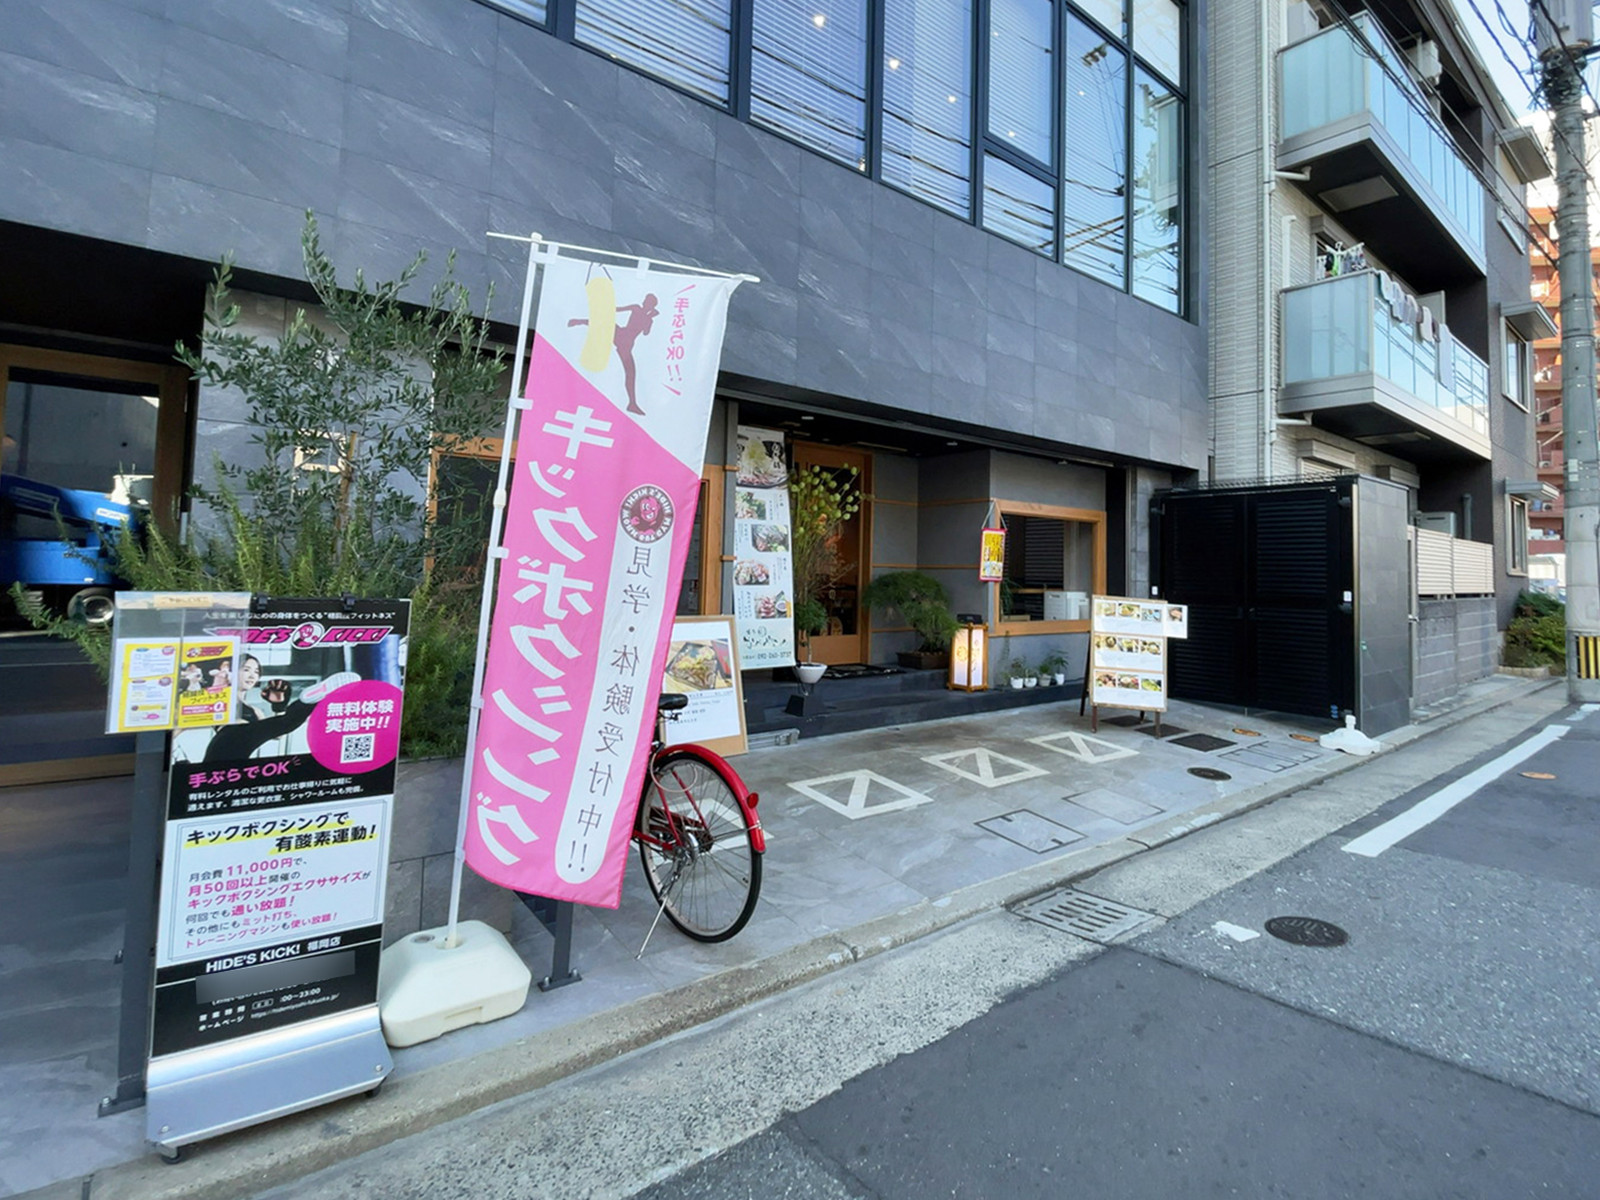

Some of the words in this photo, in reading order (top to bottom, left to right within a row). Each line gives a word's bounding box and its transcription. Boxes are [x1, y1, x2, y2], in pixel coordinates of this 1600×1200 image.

[326, 700, 394, 717] 無料体験
[325, 717, 390, 734] 実施中!!
[187, 761, 291, 788] 手ぶらでOK
[186, 812, 349, 845] キックボクシングで
[275, 825, 377, 853] 有酸素運動!
[187, 872, 301, 897] 月50回以上開催の
[187, 870, 372, 909] キックボクシングエクササイズが
[185, 895, 296, 924] 何回でも通い放題!
[185, 912, 338, 948] トレーニングマシンも使い放題!
[205, 953, 257, 974] HIDE'S
[260, 943, 301, 962] KICK!
[307, 936, 342, 951] 福岡店
[198, 1015, 245, 1032] ホームページ
